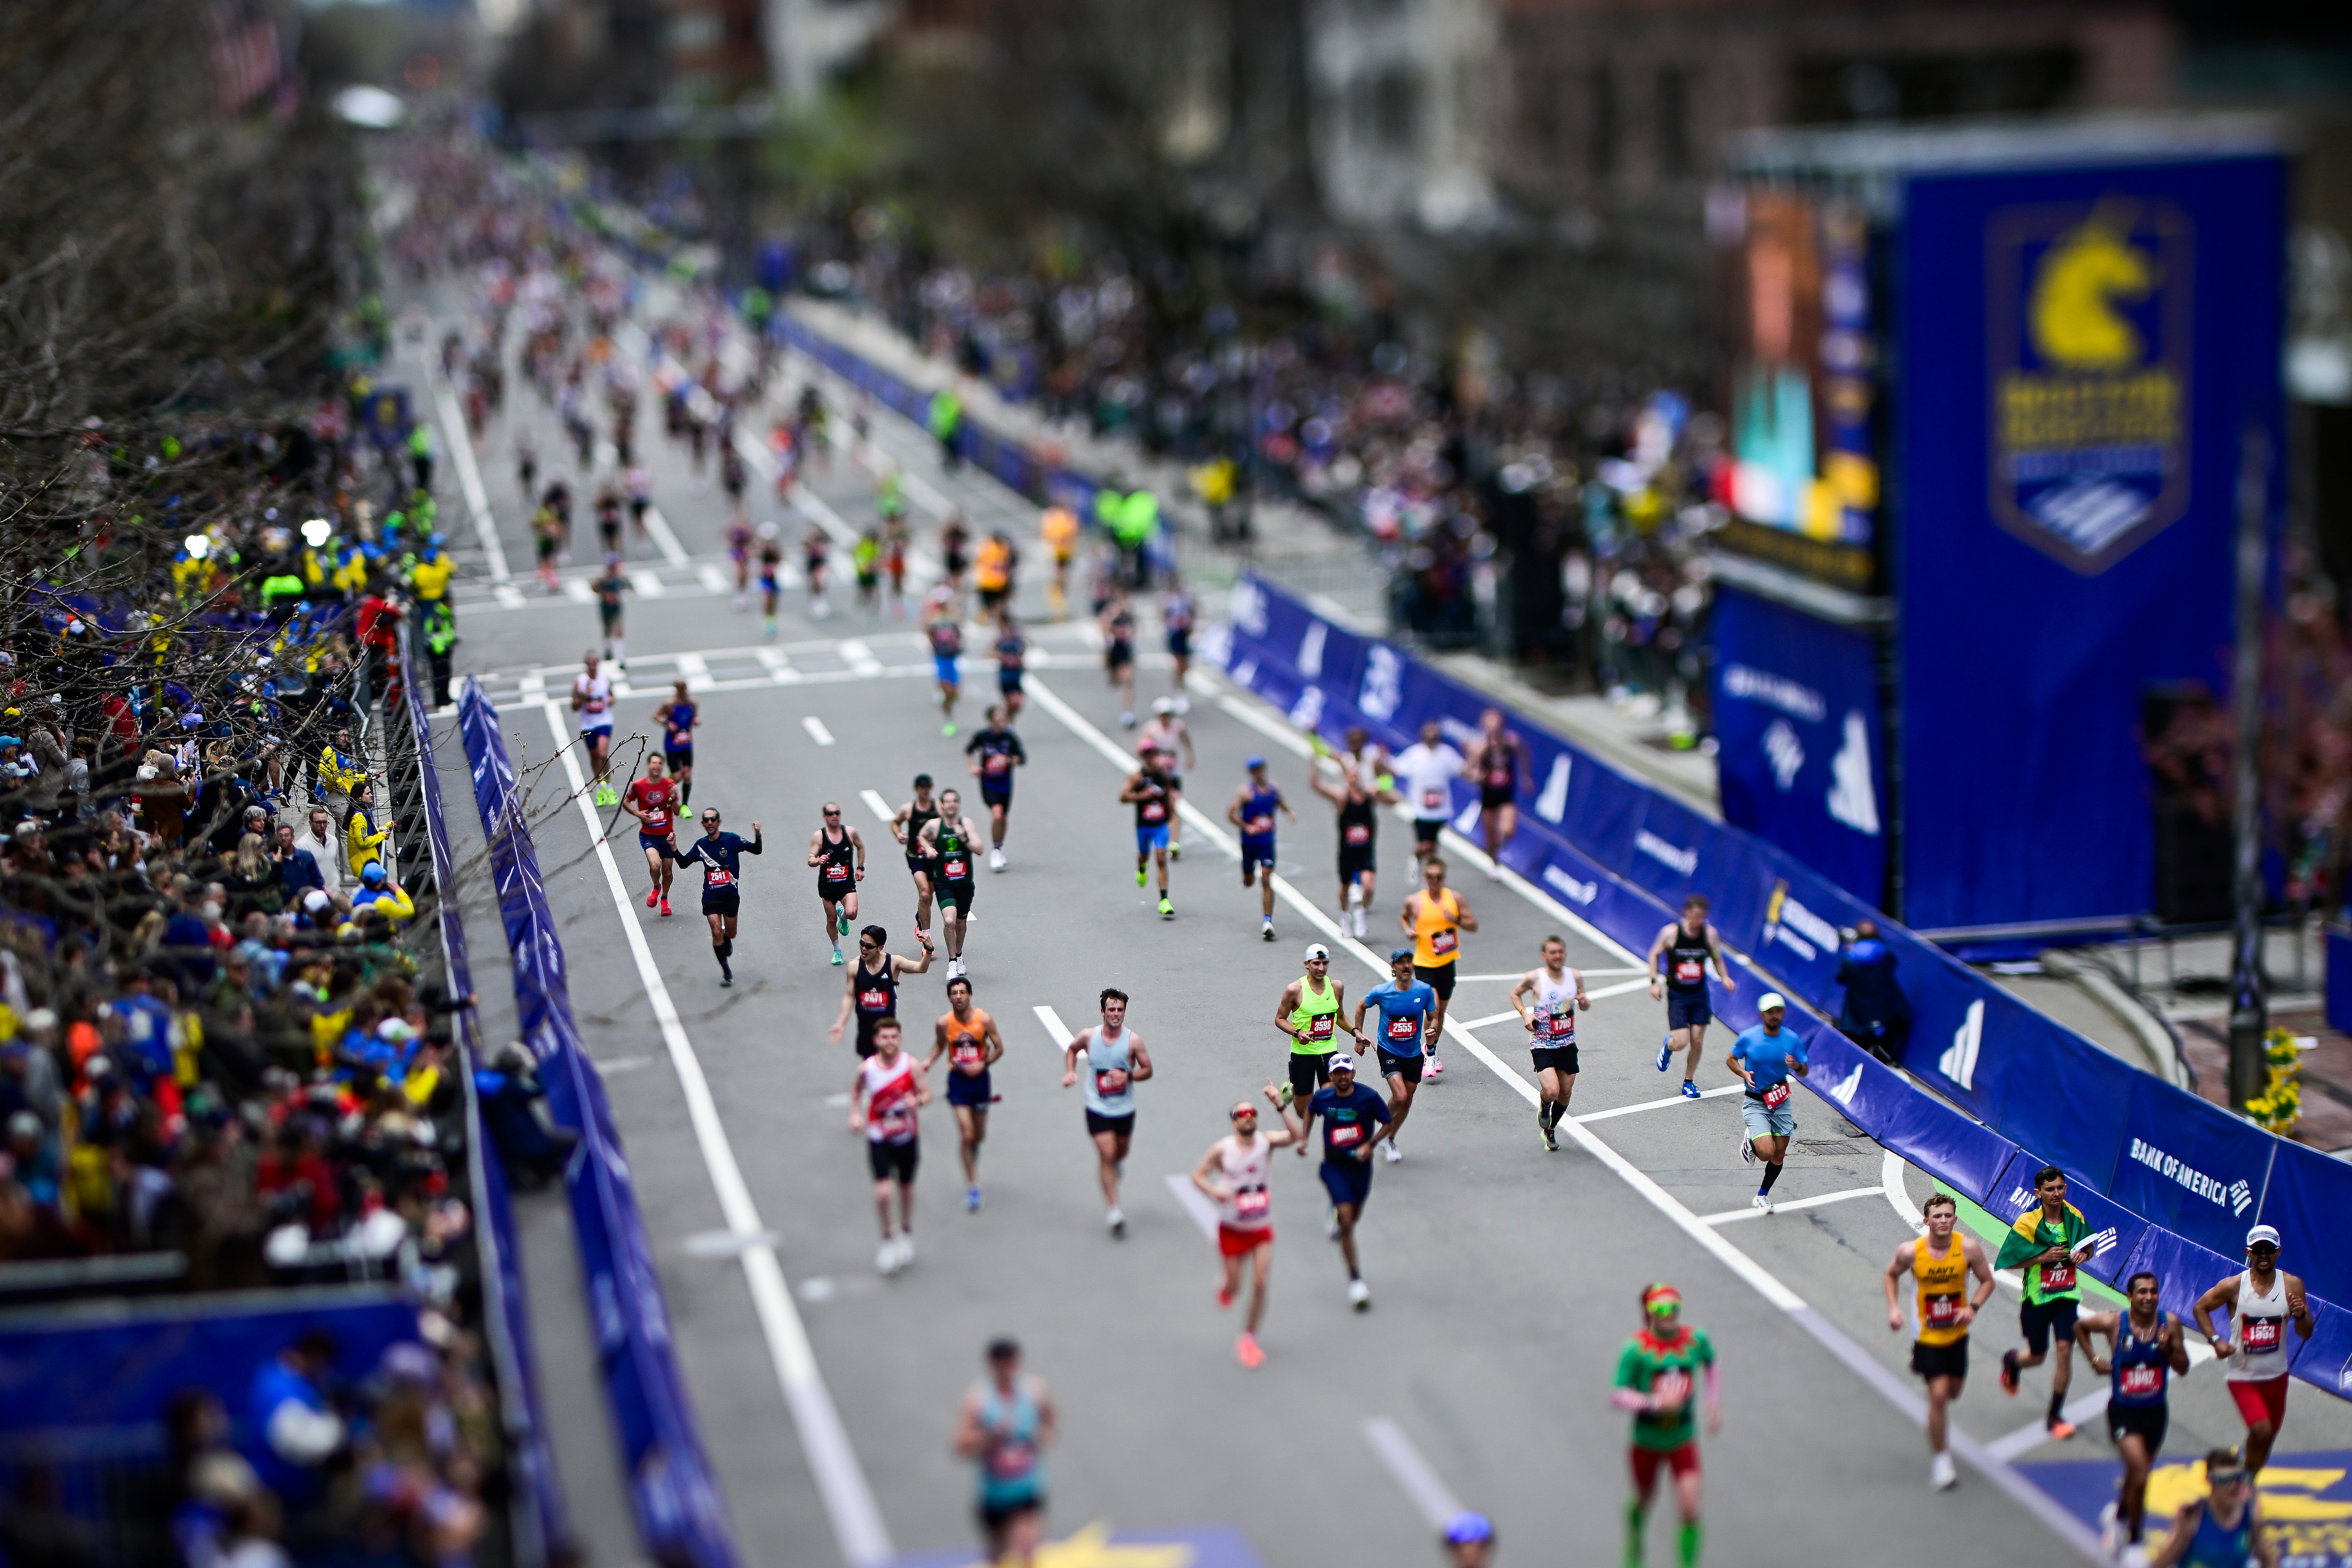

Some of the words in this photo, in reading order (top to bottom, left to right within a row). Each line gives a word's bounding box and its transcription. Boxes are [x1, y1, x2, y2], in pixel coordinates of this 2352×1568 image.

[711, 871, 726, 881] 2541
[1314, 1020, 1331, 1031] 3598
[1393, 1023, 1412, 1032] 2555
[2130, 1138, 2165, 1172] BANK
[2162, 1155, 2180, 1179] OF
[2176, 1163, 2227, 1207] AMERICA
[2009, 1186, 2038, 1212] BAN
[1929, 1266, 1955, 1275] NAVY
[2050, 1269, 2067, 1282] 787
